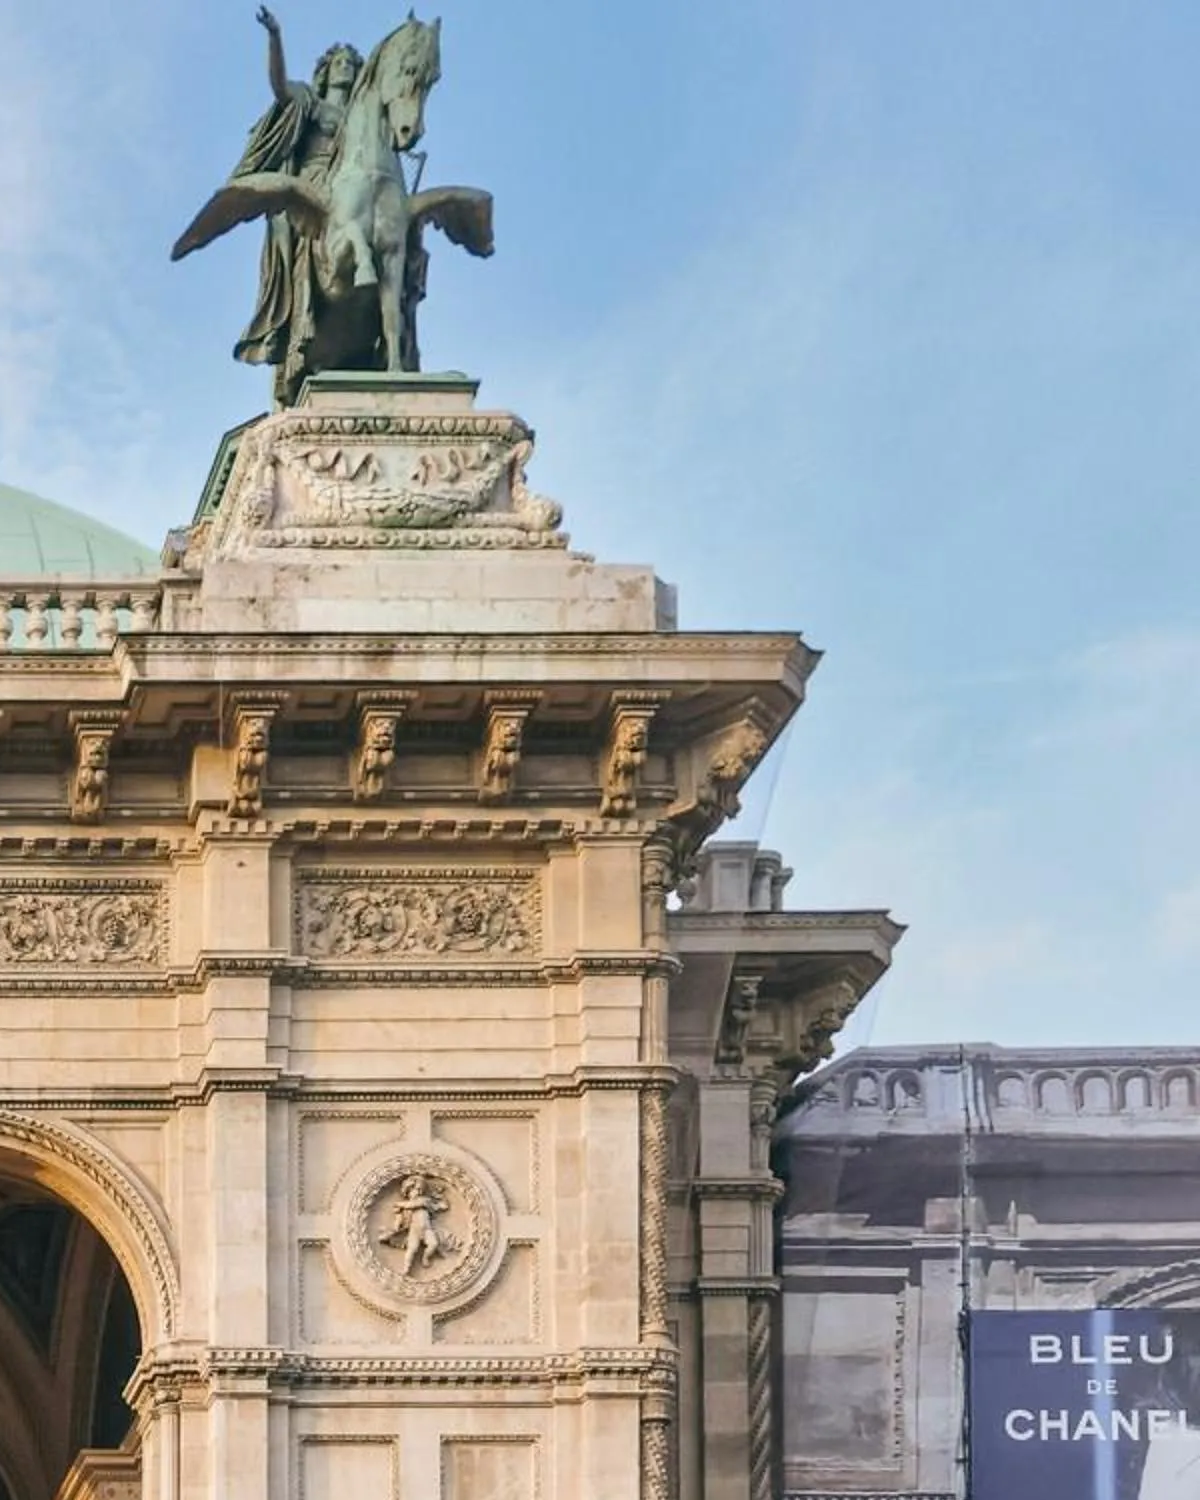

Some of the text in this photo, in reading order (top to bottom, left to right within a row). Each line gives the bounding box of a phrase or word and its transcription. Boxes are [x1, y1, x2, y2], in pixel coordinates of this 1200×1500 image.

[1030, 1334, 1173, 1365] BLEU
[1087, 1379, 1119, 1395] DE
[1004, 1408, 1200, 1441] CHANEL
